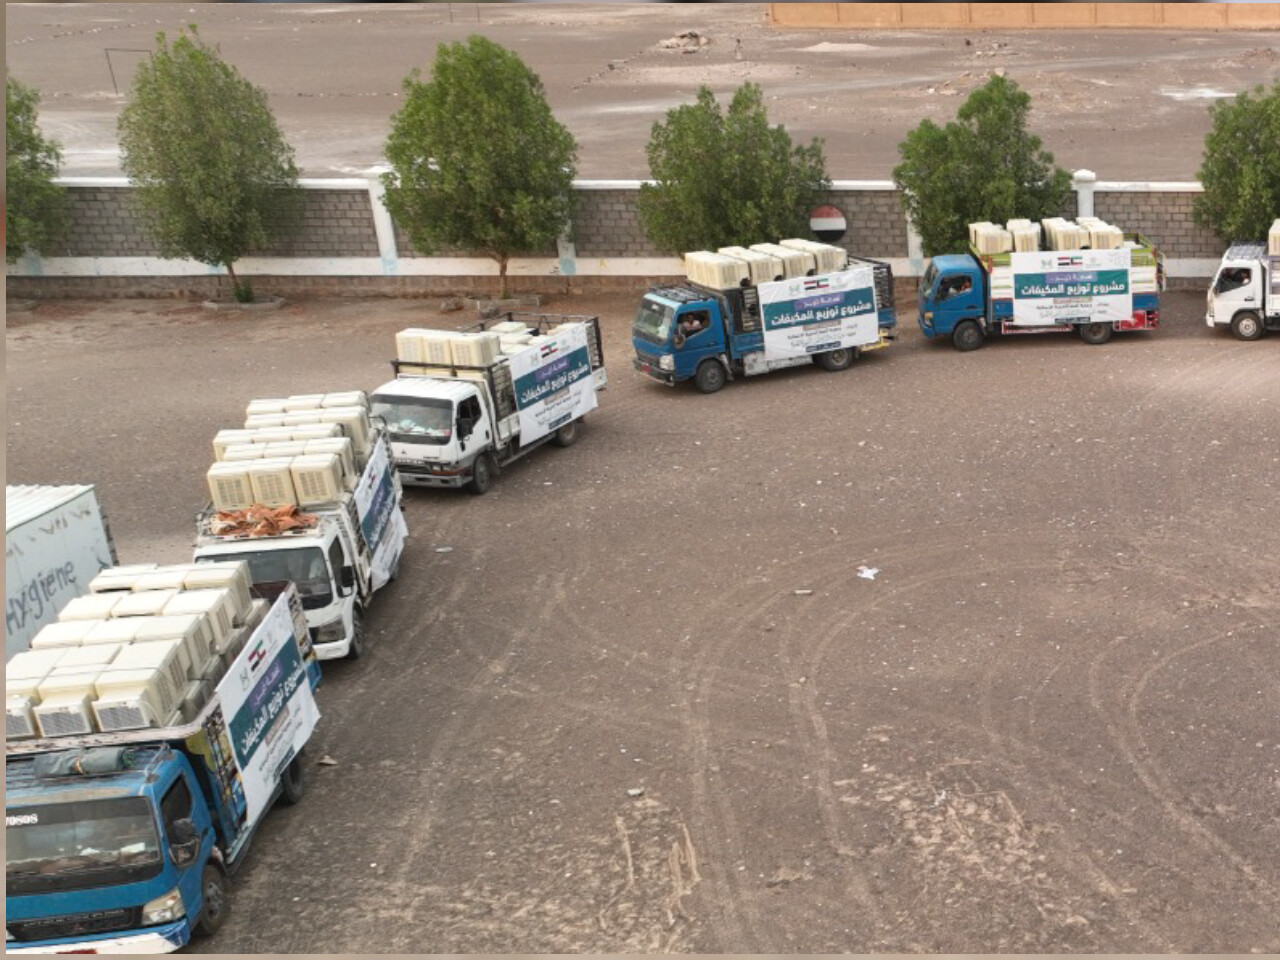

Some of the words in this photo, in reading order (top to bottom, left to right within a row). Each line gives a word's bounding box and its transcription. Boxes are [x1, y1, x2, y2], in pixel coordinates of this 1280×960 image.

[1021, 284, 1065, 297] المكيفات
[1067, 283, 1091, 295] توزيع
[1093, 281, 1125, 295] مشروع
[816, 305, 839, 321] توزيع
[841, 300, 872, 317] مشروع
